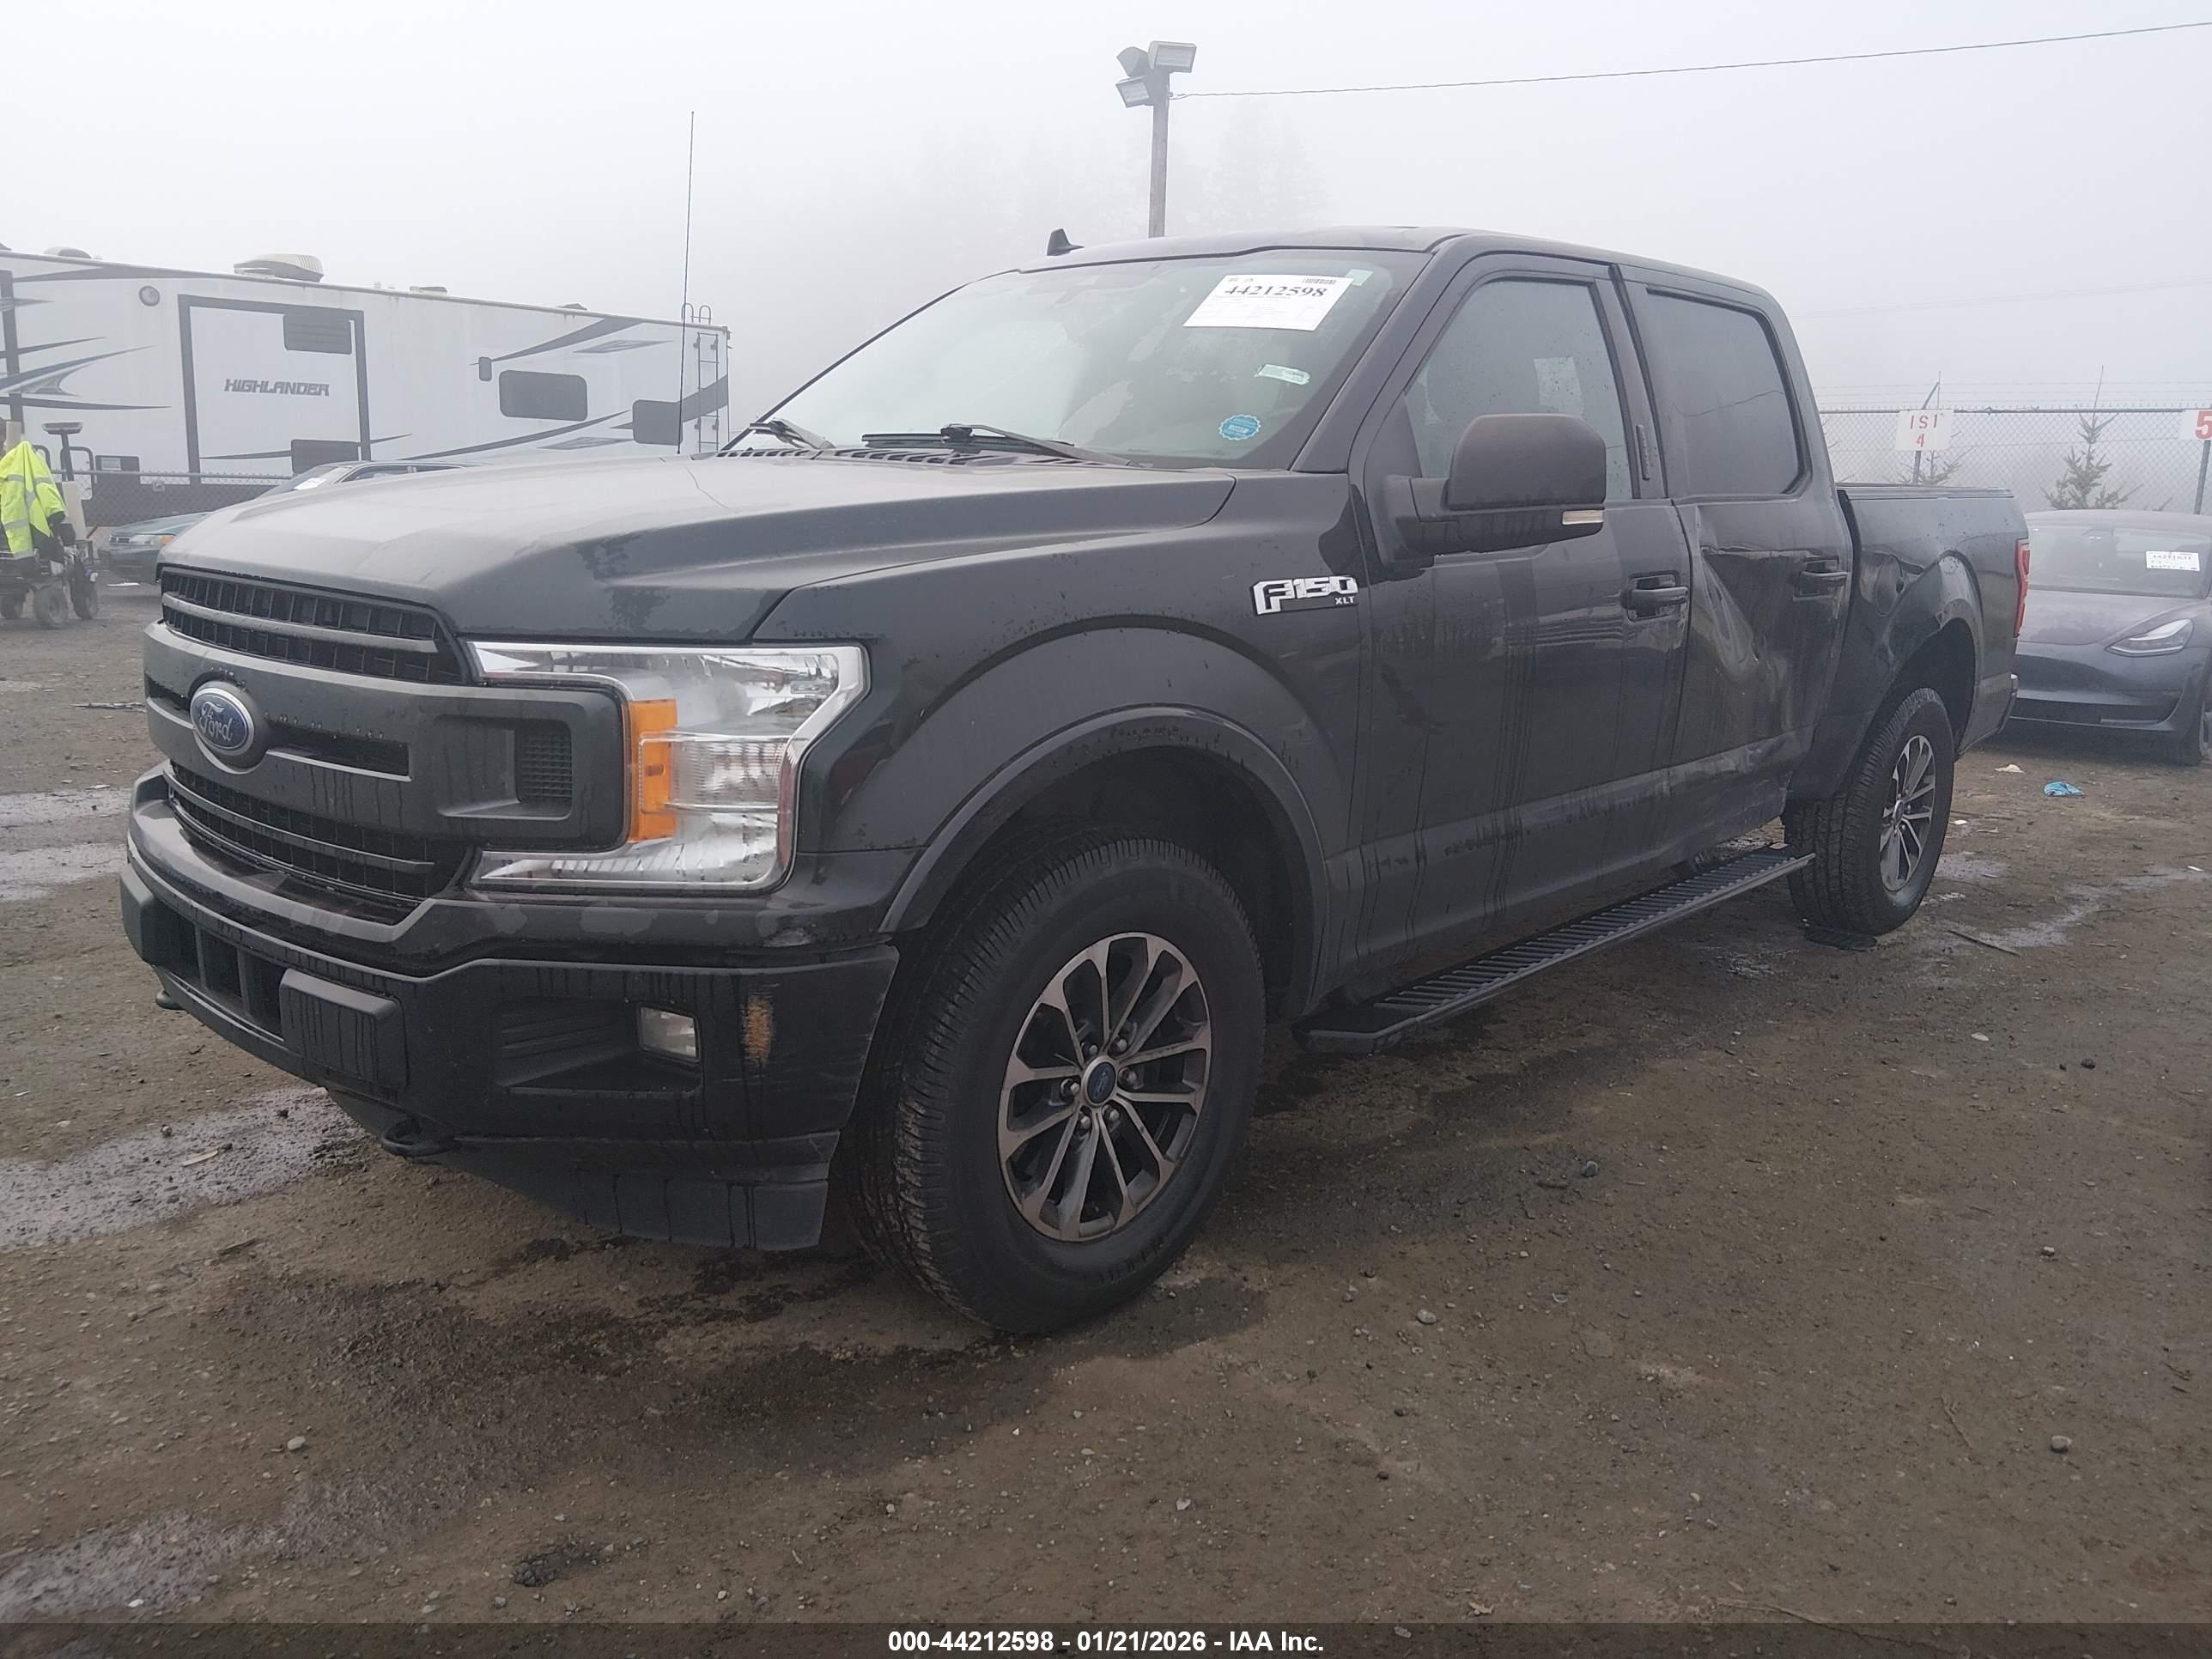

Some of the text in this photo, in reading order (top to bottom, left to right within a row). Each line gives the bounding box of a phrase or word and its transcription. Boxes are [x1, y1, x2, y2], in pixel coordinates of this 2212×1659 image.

[1224, 284, 1328, 298] 44212598
[224, 378, 330, 397] HIGHLANDER
[1916, 434, 1925, 448] 4
[1335, 596, 1355, 605] XLT
[198, 701, 234, 741] Ford
